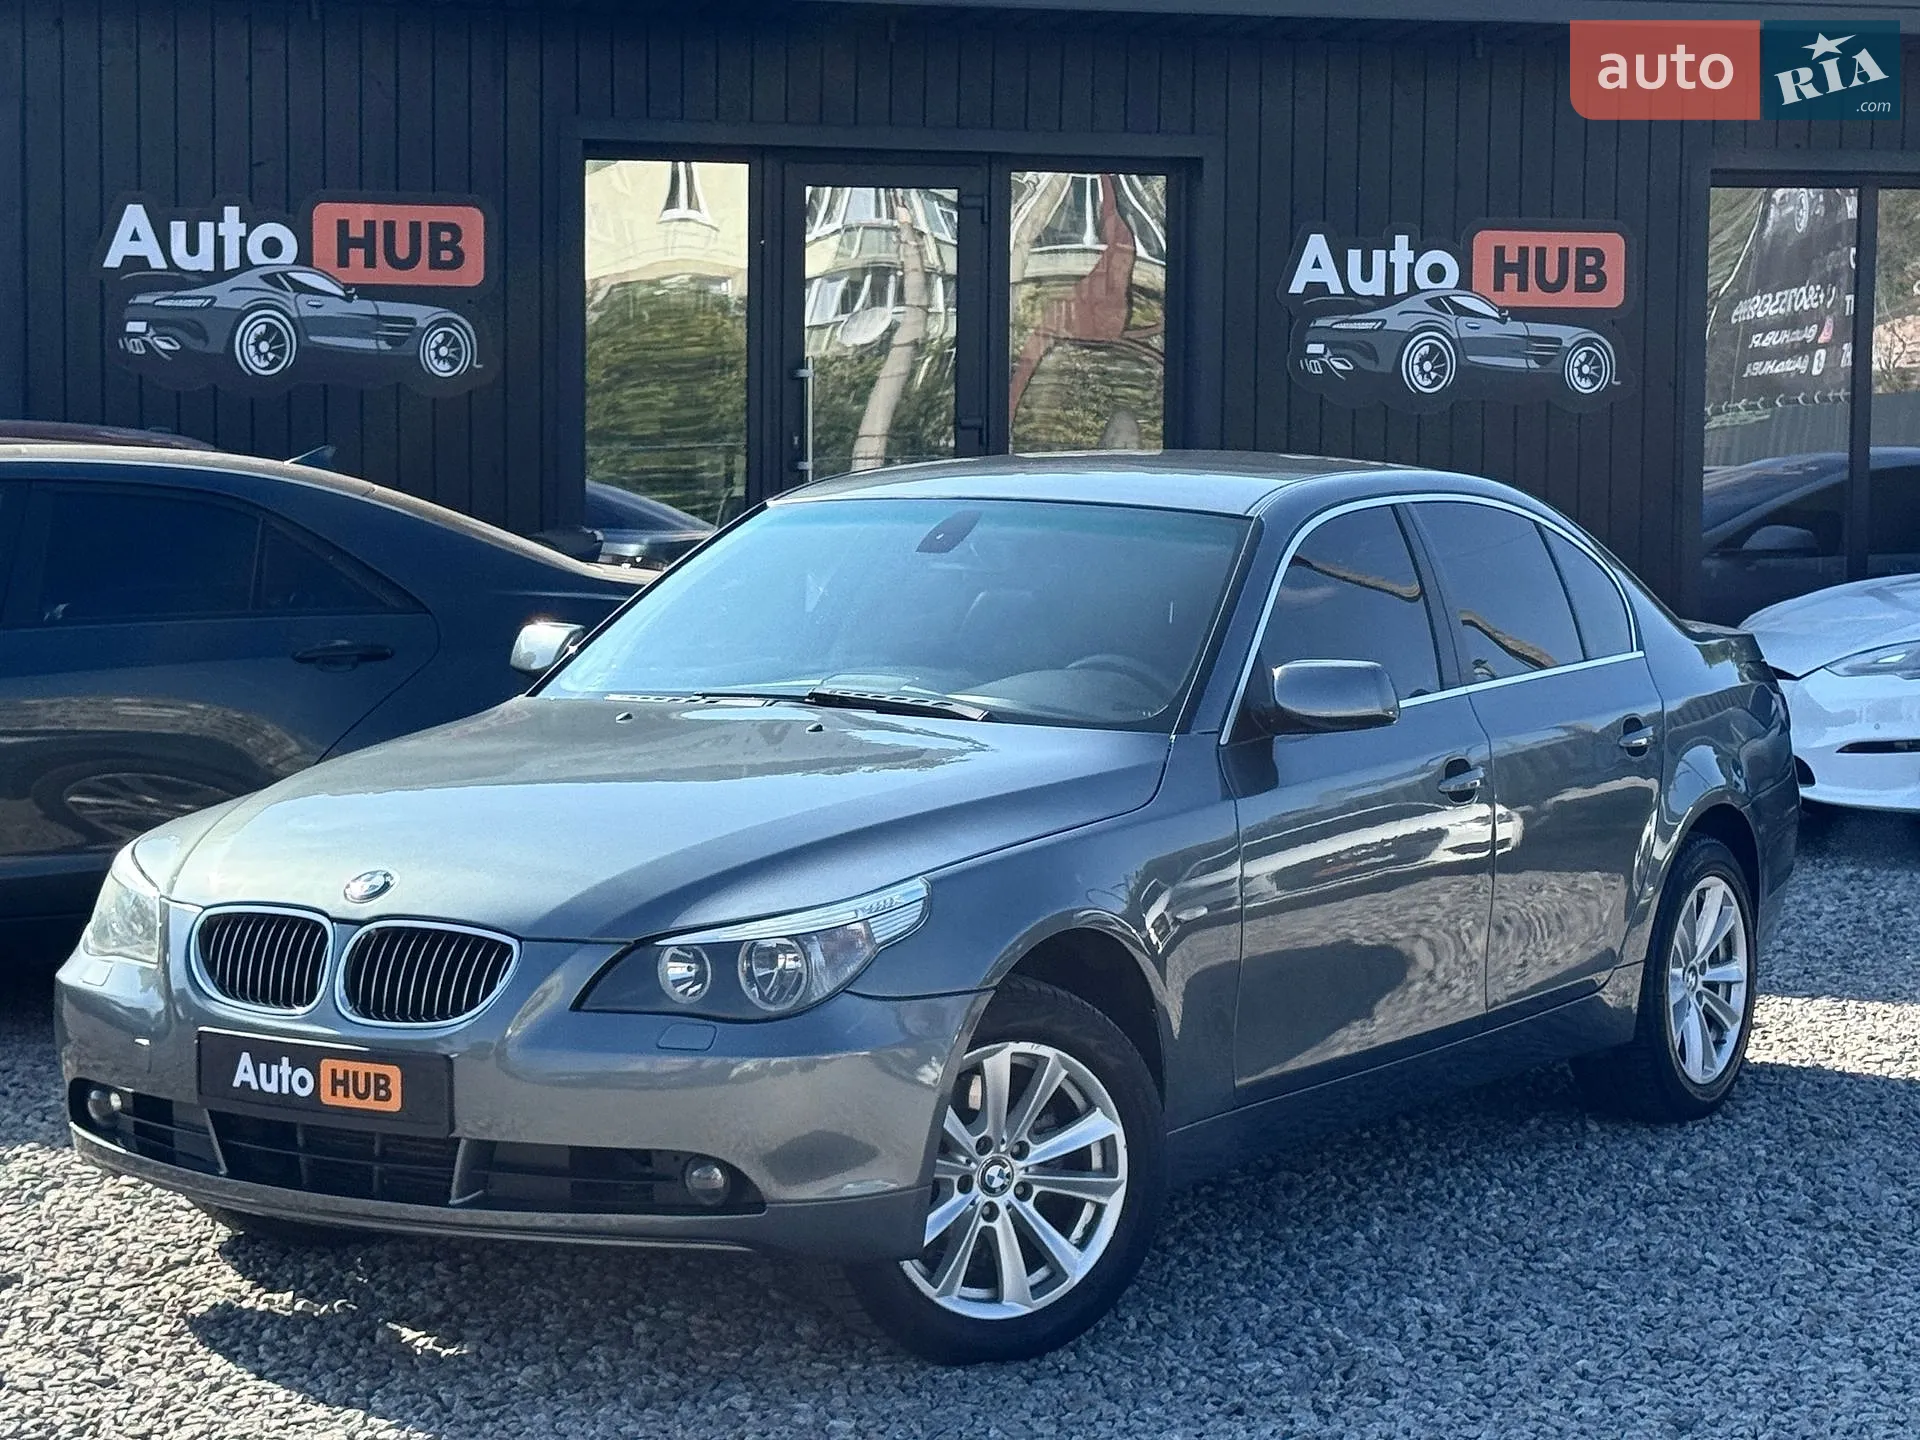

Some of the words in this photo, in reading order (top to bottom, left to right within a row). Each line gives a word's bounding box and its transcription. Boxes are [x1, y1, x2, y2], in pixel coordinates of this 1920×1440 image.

[103, 203, 298, 272] Auto
[336, 219, 466, 271] HUB
[1288, 233, 1460, 297] Auto
[1493, 245, 1608, 293] HUB
[232, 1051, 315, 1097] Auto
[330, 1067, 393, 1102] HUB
